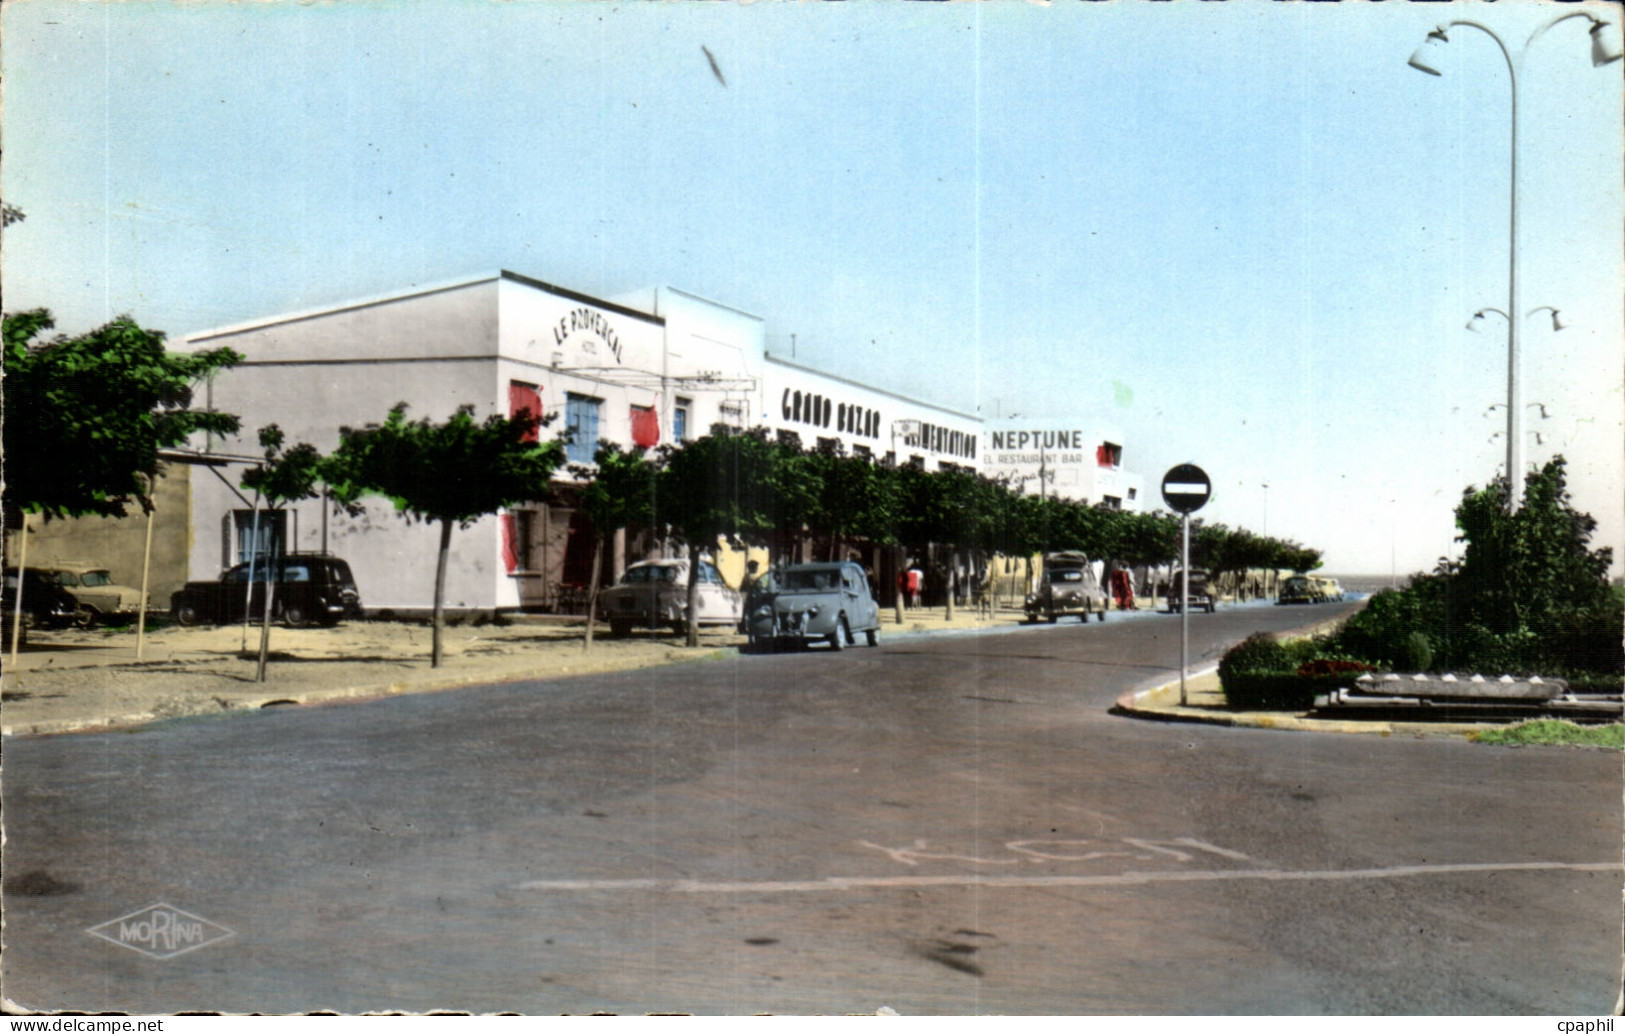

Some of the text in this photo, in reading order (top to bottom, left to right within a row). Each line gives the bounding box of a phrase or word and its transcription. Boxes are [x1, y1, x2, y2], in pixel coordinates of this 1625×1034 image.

[553, 317, 569, 346] LE
[782, 387, 880, 439] GRAND BAZAR
[992, 430, 1082, 449] NEPTUNE
[1061, 453, 1082, 463] BAR
